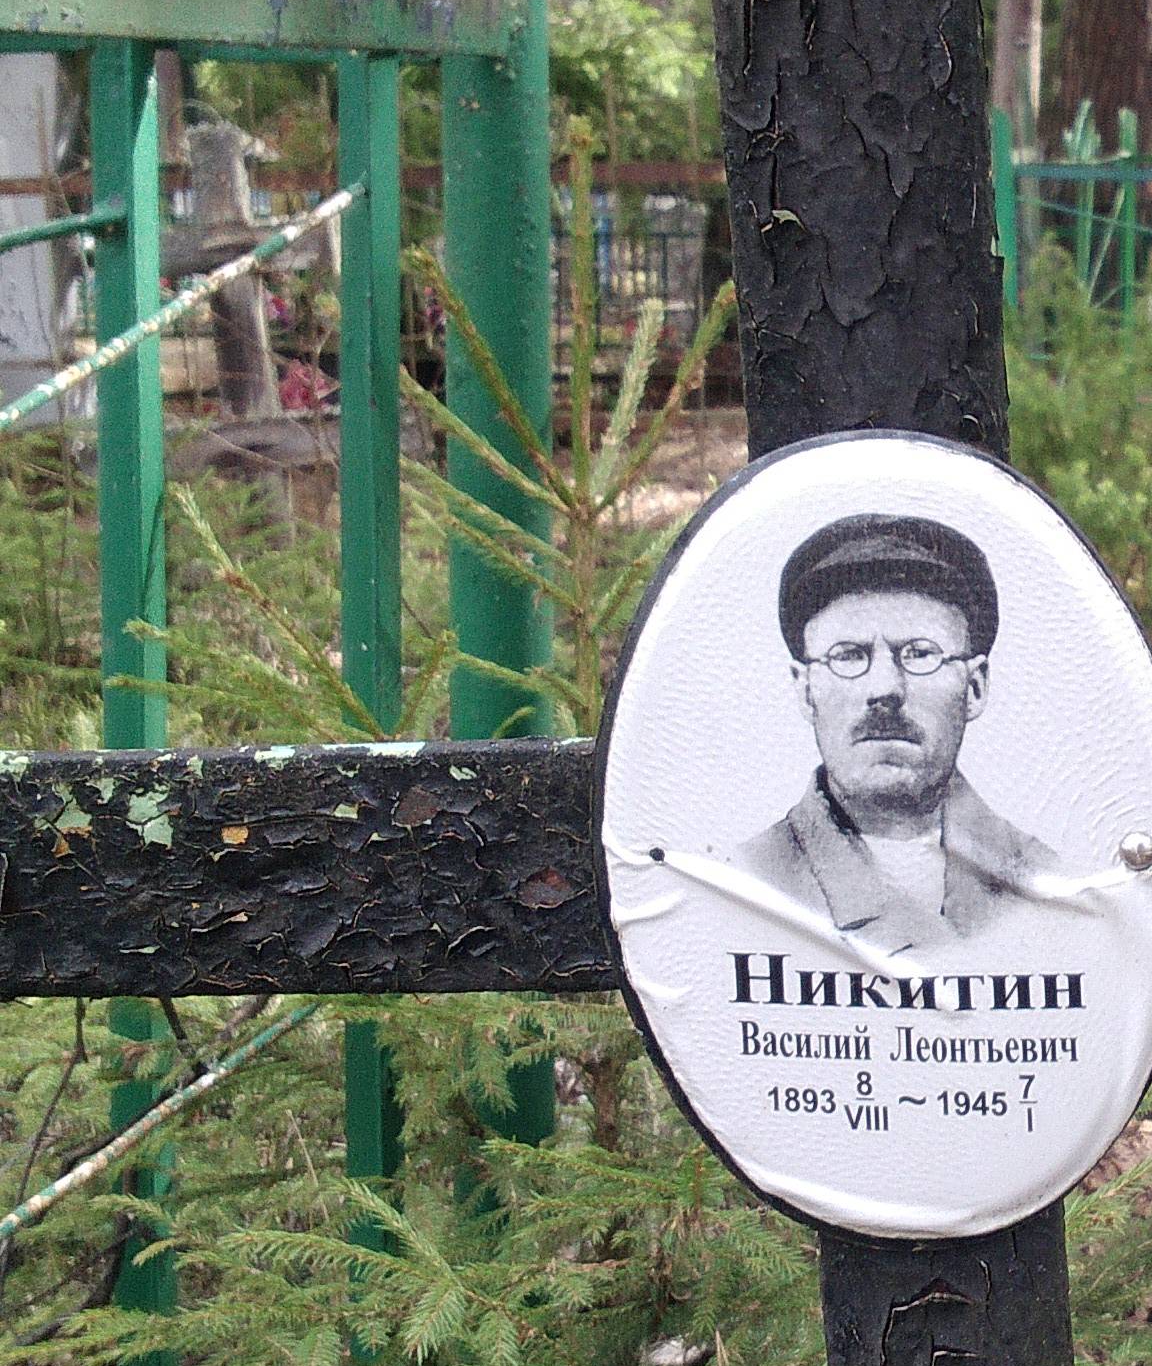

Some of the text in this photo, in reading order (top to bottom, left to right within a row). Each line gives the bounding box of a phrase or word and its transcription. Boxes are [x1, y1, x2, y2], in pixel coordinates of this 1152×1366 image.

[727, 952, 1087, 1011] Никитин
[739, 1020, 1079, 1063] Василий Леонтьевич
[856, 1071, 873, 1096] 8
[1019, 1074, 1036, 1099] 7
[768, 1086, 837, 1114] 1893
[937, 1090, 1008, 1116] 1945
[843, 1104, 889, 1131] VIII
